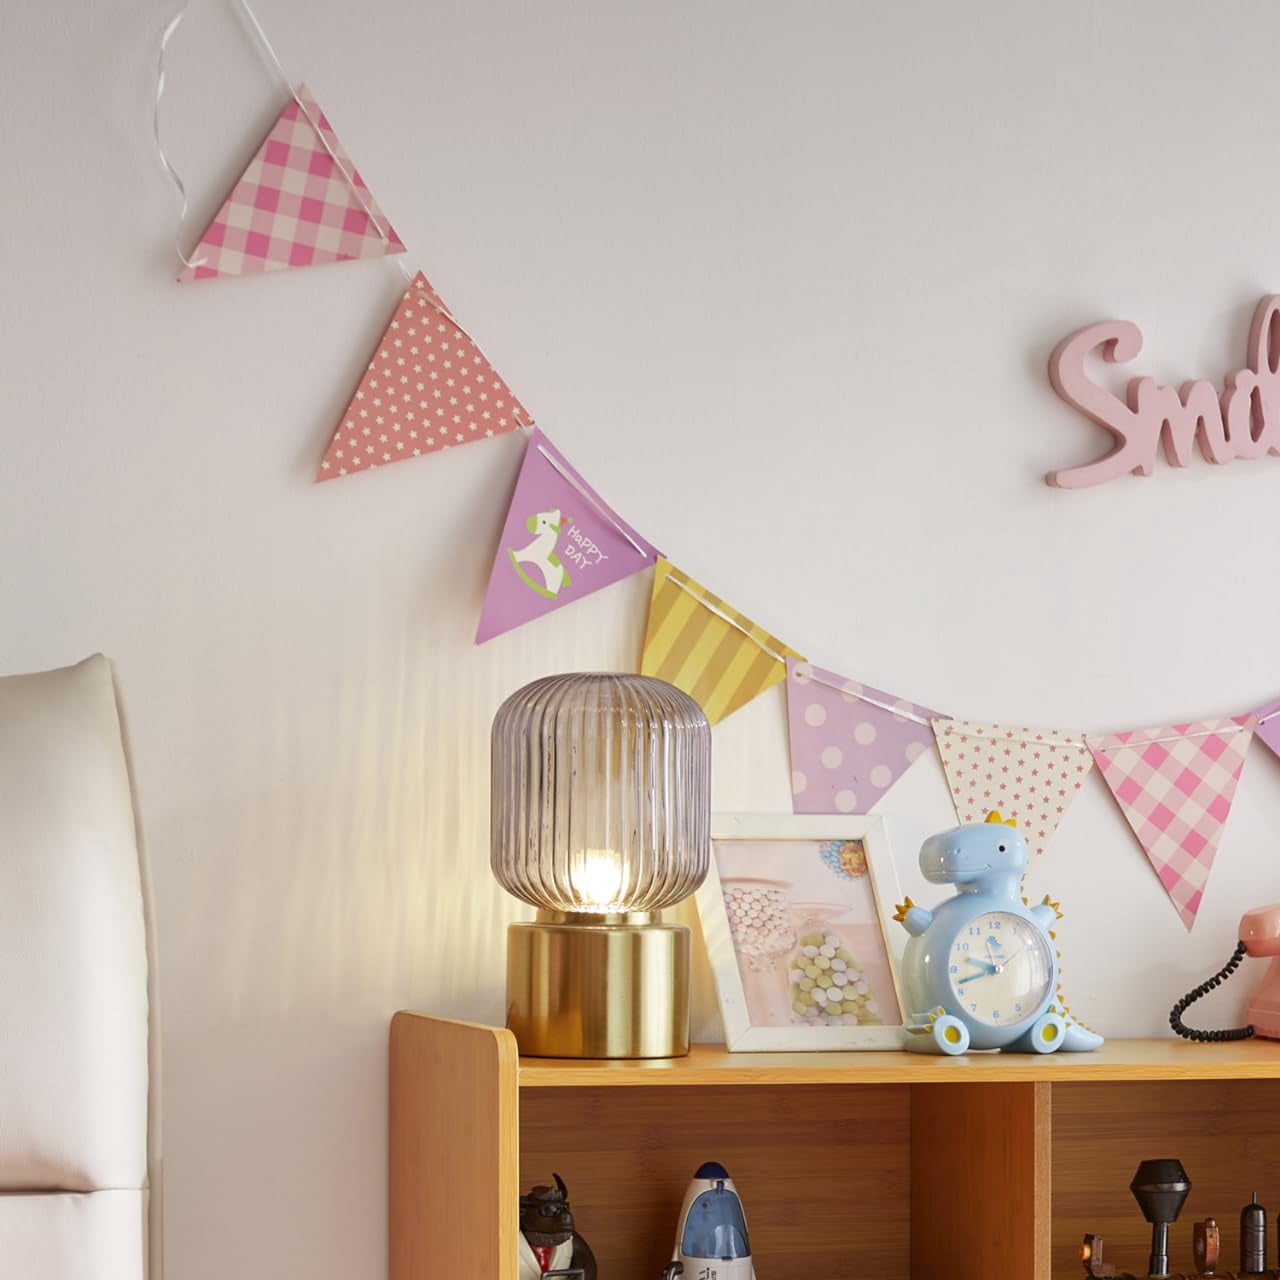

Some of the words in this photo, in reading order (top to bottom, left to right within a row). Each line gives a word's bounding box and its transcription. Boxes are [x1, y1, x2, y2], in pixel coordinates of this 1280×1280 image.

[564, 544, 593, 569] DAY
[988, 921, 1001, 929] 12
[956, 943, 969, 951] 10
[958, 988, 965, 997] 8
[993, 1010, 1000, 1019] 6
